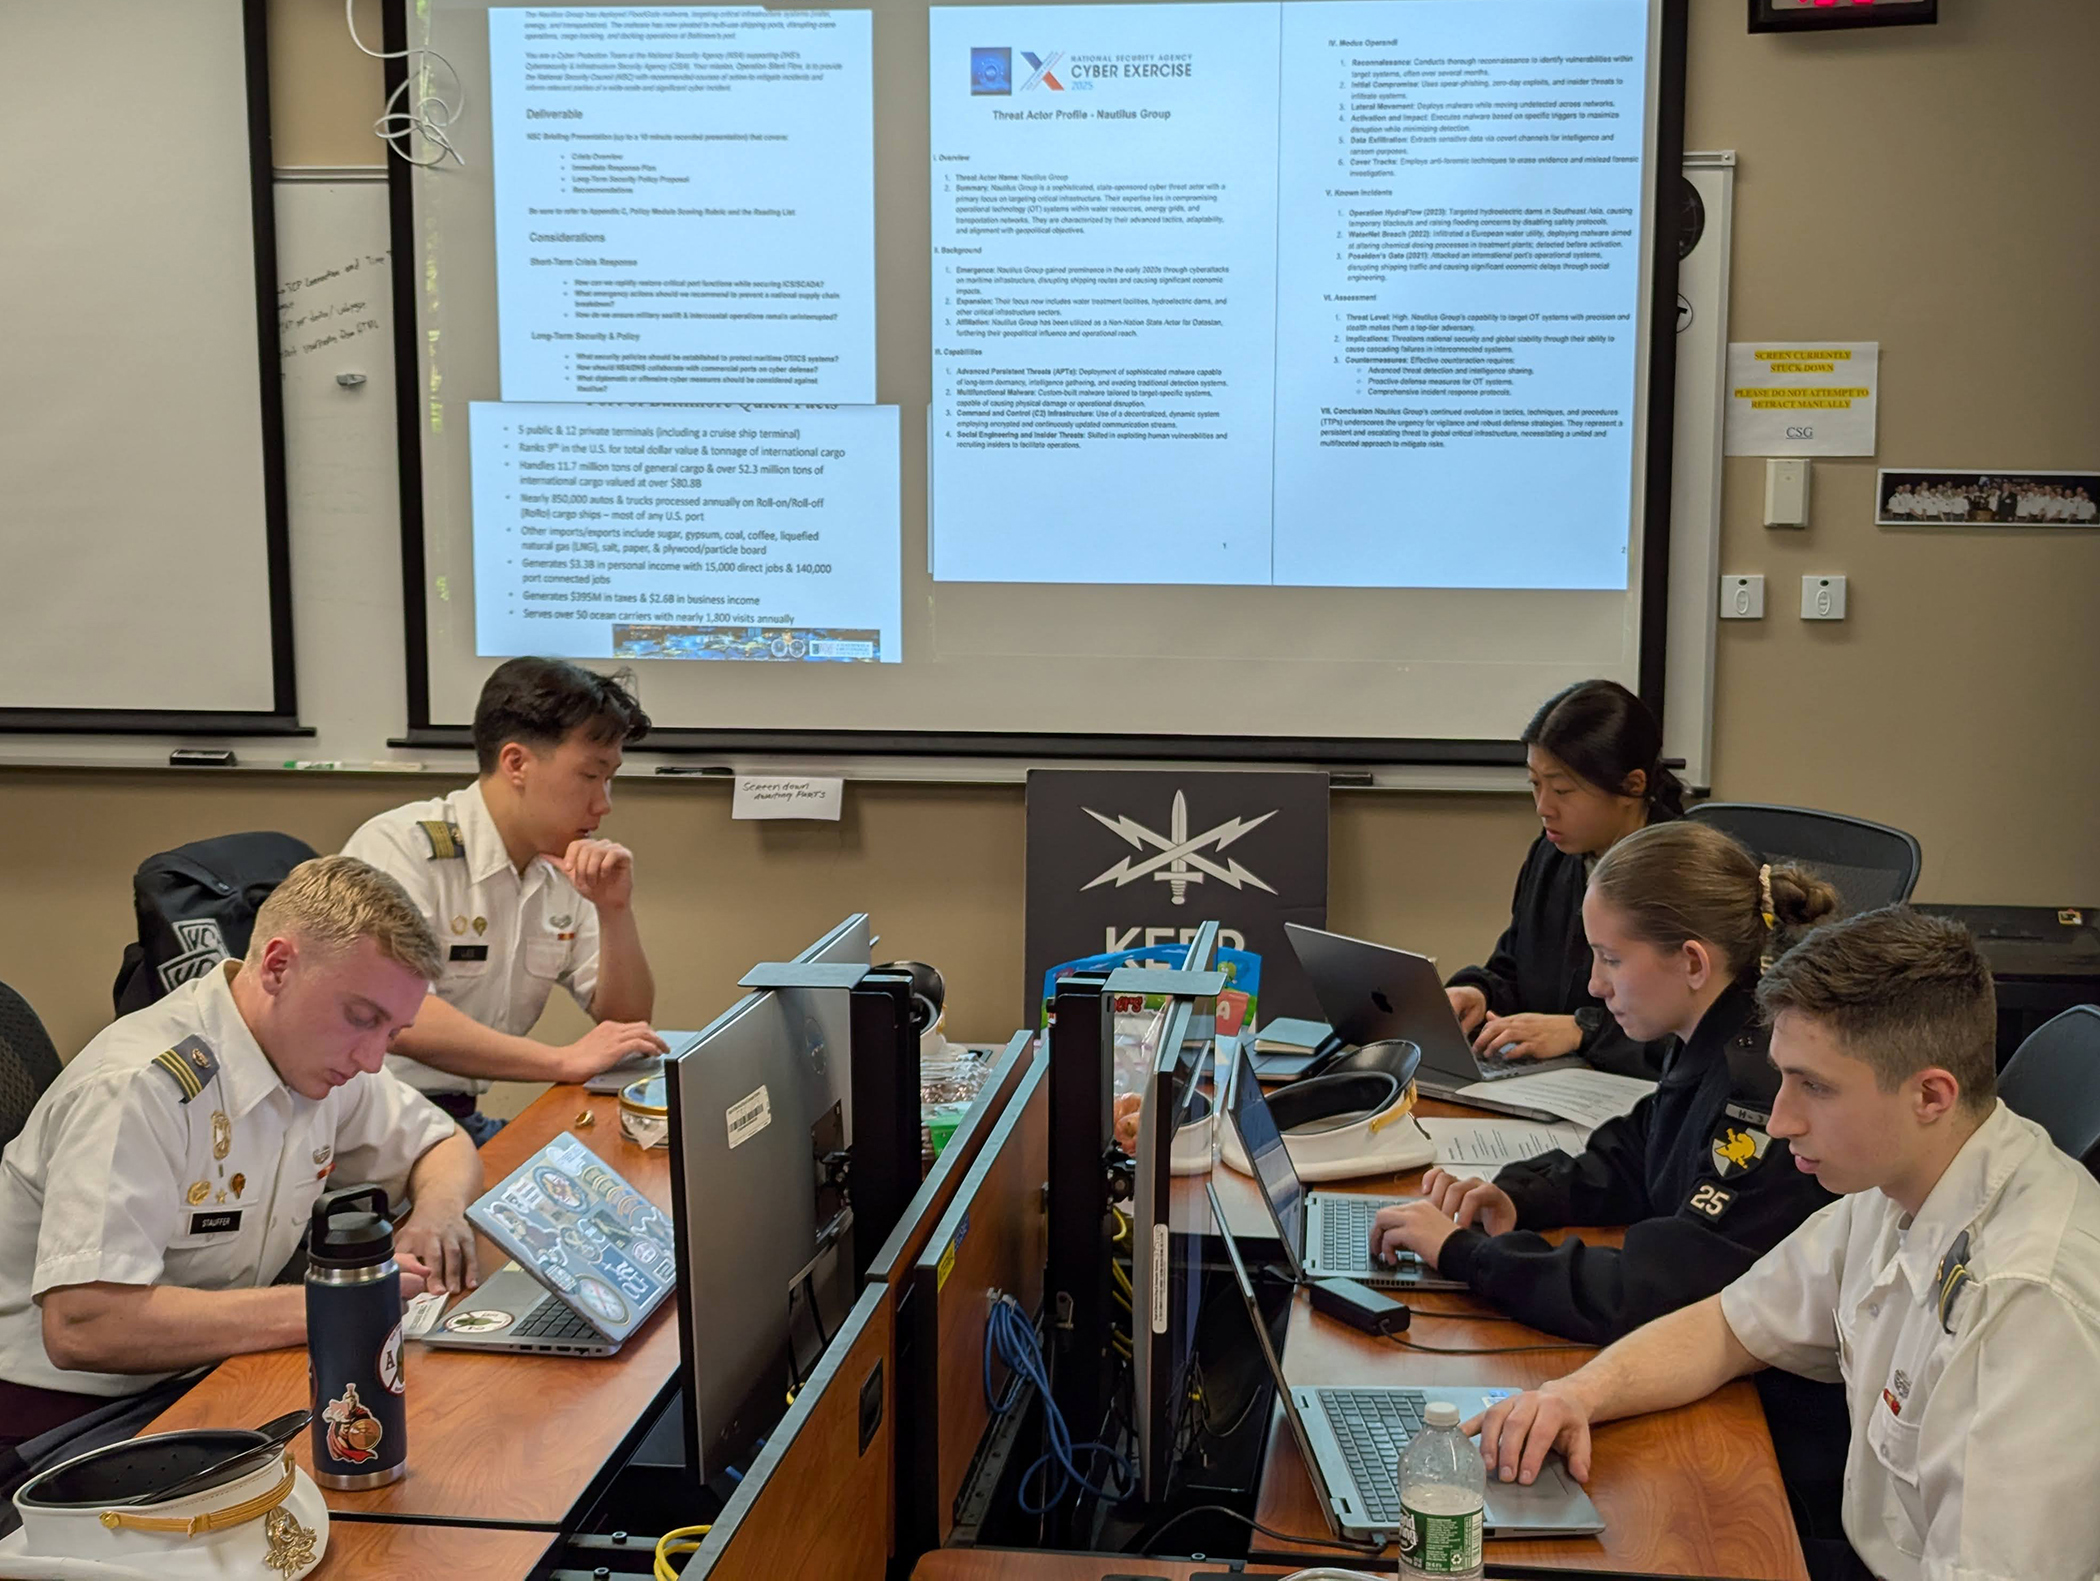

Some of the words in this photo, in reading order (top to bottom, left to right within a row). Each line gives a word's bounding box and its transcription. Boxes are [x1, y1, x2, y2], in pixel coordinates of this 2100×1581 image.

[1071, 64, 1118, 78] CYBER
[1124, 64, 1192, 77] EXERCISE
[1071, 81, 1094, 90] 2025
[526, 109, 583, 120] Deliverable
[993, 110, 1024, 120] Threat
[1026, 110, 1053, 120] Actor
[1056, 110, 1088, 120] Profile
[1097, 110, 1137, 119] Nautilus
[1140, 110, 1171, 121] Group
[529, 232, 606, 243] Considerations
[1755, 351, 1791, 360] SCREEN
[1793, 351, 1851, 360] CURRENTLY
[1771, 364, 1802, 372] STUCK
[1804, 364, 1834, 372] DOWN
[1735, 389, 1768, 397] PLEASE
[1773, 389, 1786, 397] DO
[1788, 389, 1808, 397] NOT
[1810, 389, 1854, 397] ATTEMPT
[1856, 389, 1869, 397] TO
[1752, 400, 1794, 408] RETRACT
[1799, 400, 1851, 408] MANUALLY
[519, 426, 524, 436] 5
[526, 426, 553, 438] public
[556, 426, 563, 436] &
[566, 426, 576, 436] 12
[579, 426, 610, 439] private
[612, 427, 654, 437] terminals
[656, 427, 700, 440] (including
[710, 428, 737, 438] cruise
[739, 428, 757, 440] ship
[759, 428, 801, 441] terminal)
[1786, 427, 1813, 438] CSG
[561, 443, 570, 453] in
[572, 443, 587, 453] the
[589, 443, 605, 453] U.S.
[609, 444, 621, 454] for
[624, 444, 645, 454] total
[647, 444, 672, 454] dollar
[675, 445, 699, 455] value
[701, 445, 708, 455] &
[711, 445, 747, 458] tonnage
[749, 446, 759, 456] of
[761, 446, 819, 457] international
[821, 449, 846, 460] cargo
[519, 461, 555, 471] Handles
[579, 462, 609, 472] million
[611, 462, 631, 472] tons
[633, 462, 643, 472] of
[645, 462, 678, 475] general
[680, 465, 705, 475] cargo
[707, 463, 714, 473] &
[760, 464, 790, 474] million
[793, 464, 812, 475] tons
[814, 465, 824, 475] of
[520, 476, 577, 486] international
[579, 479, 604, 489] cargo
[605, 477, 636, 487] valued
[638, 477, 646, 488] at
[590, 494, 614, 504] autos
[617, 494, 624, 504] &
[626, 494, 653, 505] trucks
[655, 495, 701, 508] processed
[703, 496, 741, 508] annually
[756, 497, 824, 510] Roll-on/Roll-off
[552, 511, 577, 521] cargo
[579, 509, 602, 522] ships
[611, 510, 634, 520] most
[636, 510, 645, 520] of
[648, 513, 663, 523] any
[666, 511, 682, 521] U.S.
[685, 511, 705, 524] port
[521, 525, 547, 536] Other
[549, 526, 621, 539] imports/exports
[622, 527, 655, 538] include
[658, 530, 682, 540] sugar,
[685, 531, 722, 541] gypsum,
[725, 529, 745, 540] coal,
[748, 529, 777, 541] coffee,
[780, 530, 820, 543] liquefied
[522, 558, 568, 569] Generates
[570, 559, 595, 570] $3.3B
[597, 559, 605, 569] in
[608, 560, 646, 572] personal
[648, 560, 681, 571] income
[683, 561, 703, 571] with
[706, 561, 736, 573] 15,000
[737, 562, 763, 572] direct
[765, 562, 784, 575] jobs
[786, 563, 793, 573] &
[797, 563, 832, 574] 140,000
[523, 590, 569, 601] Generates
[603, 592, 613, 602] in
[614, 592, 637, 602] taxes
[640, 592, 647, 603] &
[650, 593, 675, 604] $2.6B
[676, 593, 685, 603] in
[687, 594, 725, 604] business
[727, 594, 760, 605] income
[523, 608, 553, 618] Serves
[575, 609, 589, 619] 50
[589, 612, 617, 620] ocean
[618, 610, 652, 620] carriers
[654, 611, 674, 621] with
[676, 611, 703, 624] nearly
[733, 612, 755, 622] visits
[758, 612, 795, 625] annually
[1690, 1184, 1730, 1216] 25
[202, 1217, 230, 1228] STAUFFER
[386, 1350, 396, 1371] A
